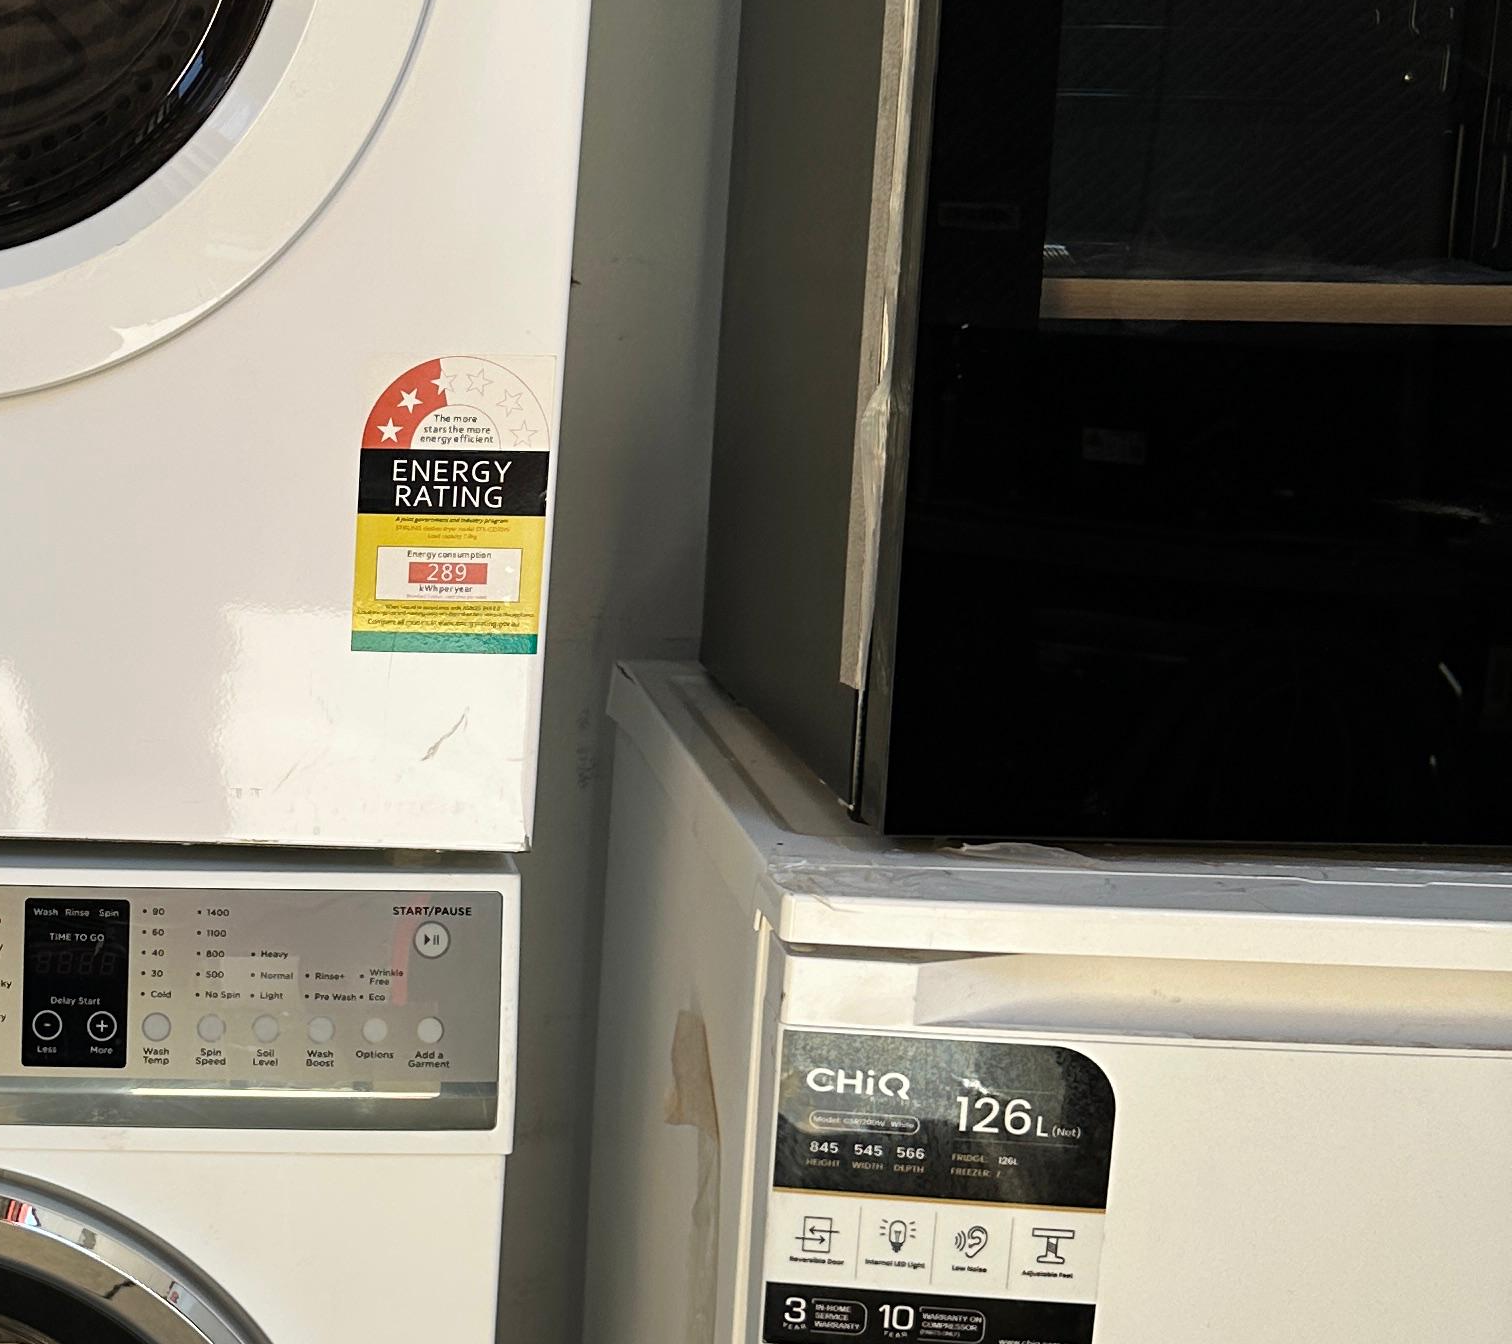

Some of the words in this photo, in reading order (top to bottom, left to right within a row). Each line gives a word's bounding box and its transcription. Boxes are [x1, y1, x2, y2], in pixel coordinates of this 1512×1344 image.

[393, 460, 512, 483] ENERGY
[395, 486, 502, 508] RATING
[426, 563, 466, 582] 289
[393, 906, 471, 917] START/PAUSE
[50, 933, 71, 941] TIME
[90, 934, 104, 942] GO
[221, 991, 240, 999] Spin
[260, 992, 283, 1000] Light
[51, 997, 76, 1006] Delay
[79, 997, 100, 1005] Start
[143, 1048, 169, 1057] Wash
[356, 1050, 393, 1059] Options
[252, 1058, 278, 1066] Level
[408, 1059, 450, 1068] Garment
[806, 1068, 910, 1100] CHiQ
[810, 1141, 838, 1153] 845
[855, 1144, 882, 1156] 545
[897, 1147, 924, 1159] 566
[784, 1297, 806, 1322] 3
[879, 1305, 914, 1330] 10
